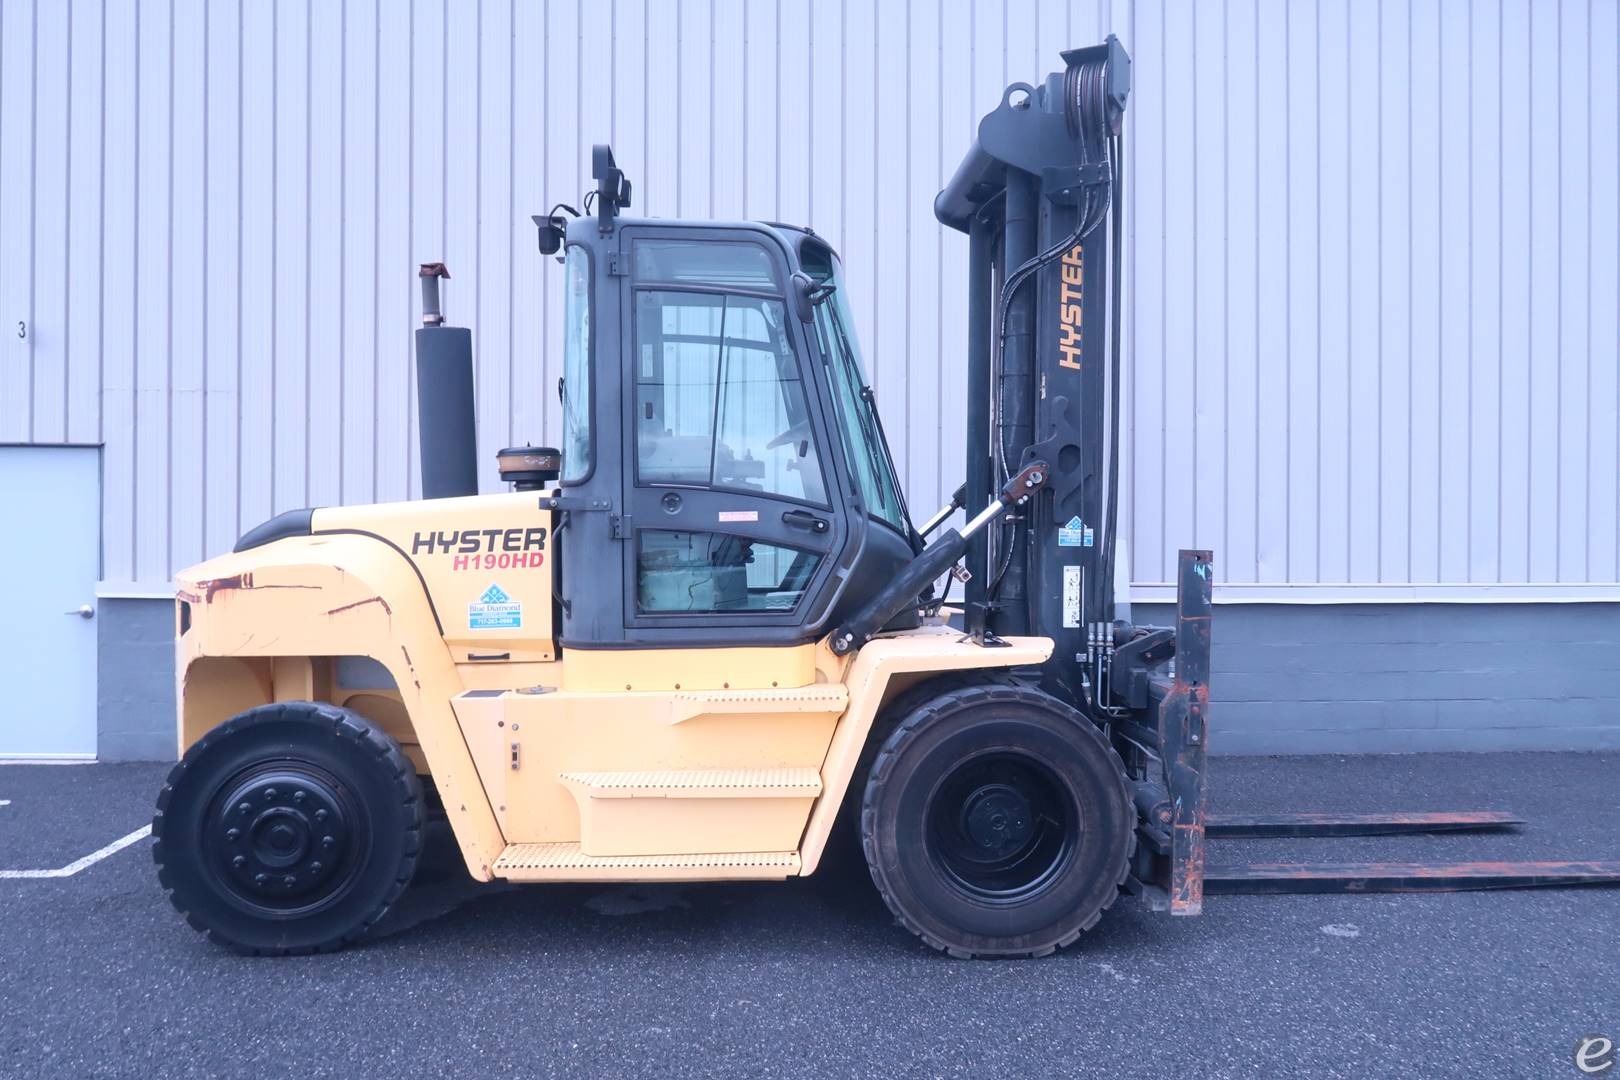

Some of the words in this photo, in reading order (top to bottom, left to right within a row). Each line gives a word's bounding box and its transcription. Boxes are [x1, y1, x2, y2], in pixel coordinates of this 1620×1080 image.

[18, 320, 26, 339] 3
[411, 527, 547, 555] HYSTER
[453, 552, 544, 571] H190HD
[487, 602, 521, 611] Diamond
